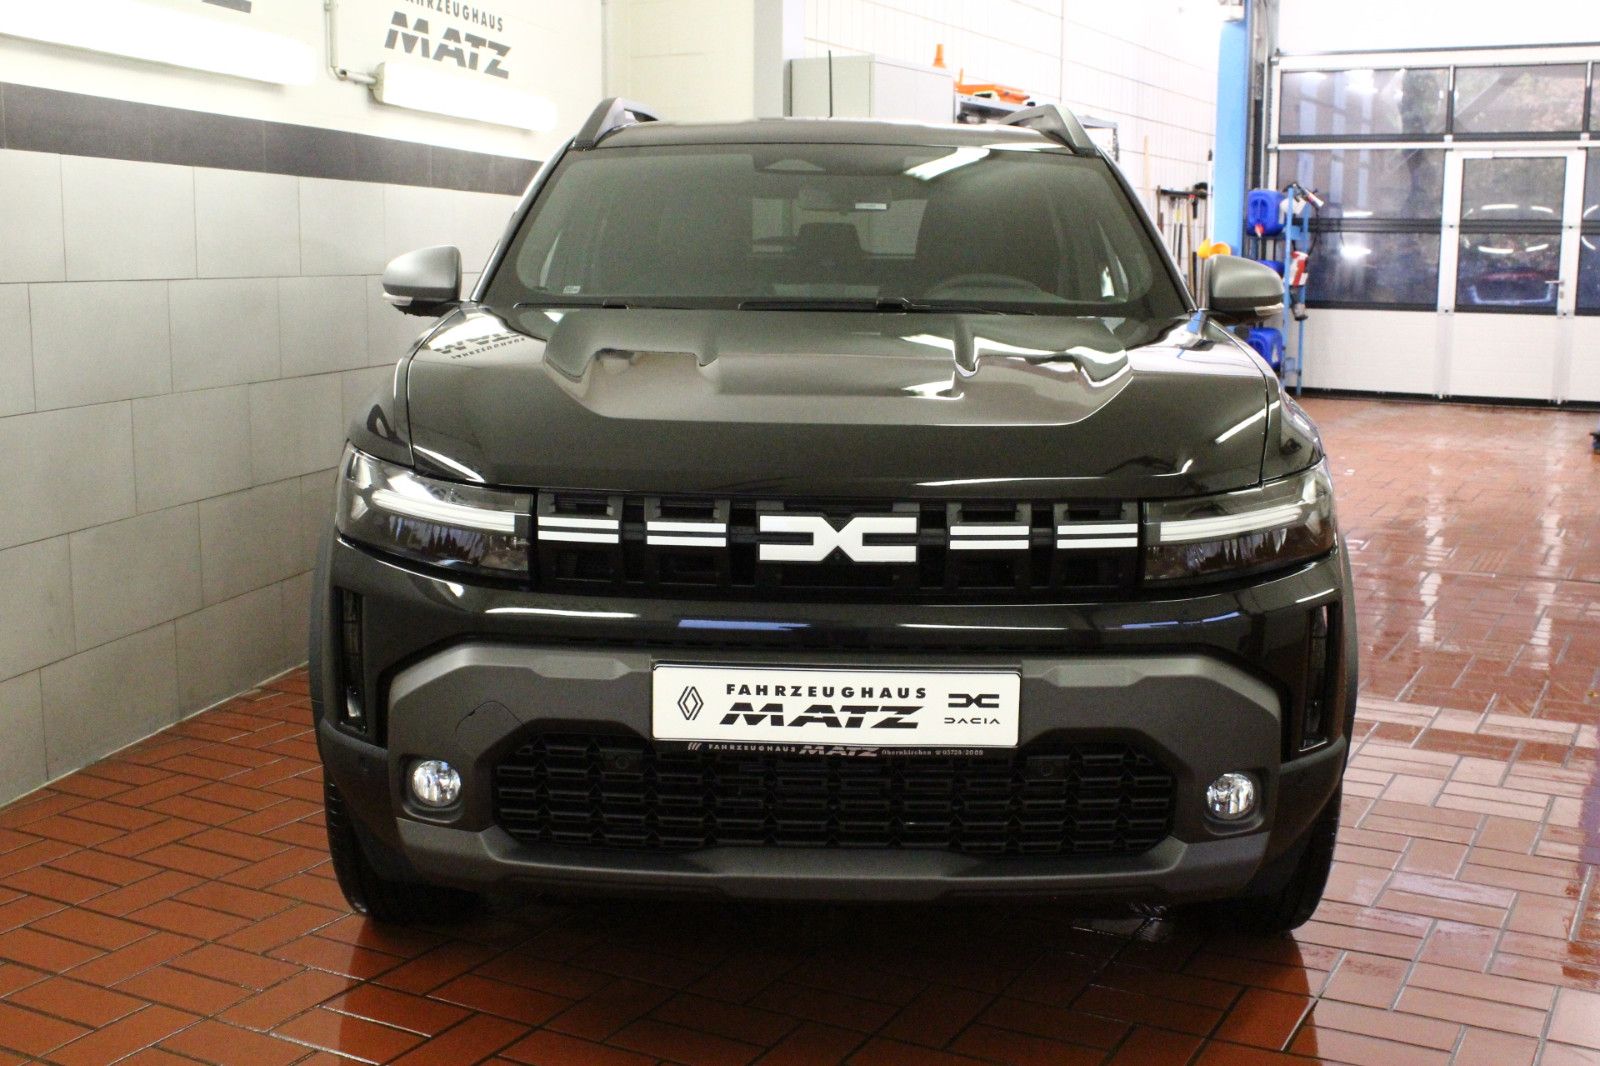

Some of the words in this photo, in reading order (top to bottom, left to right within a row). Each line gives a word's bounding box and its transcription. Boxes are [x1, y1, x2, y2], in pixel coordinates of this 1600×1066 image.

[384, 11, 511, 79] MATZ
[726, 683, 927, 699] FAHRZEUGHAUS
[719, 702, 925, 729] MATZ
[944, 717, 1001, 725] DACIA
[708, 743, 796, 753] FAHRZEUGHAUS
[799, 745, 880, 757] MATZ
